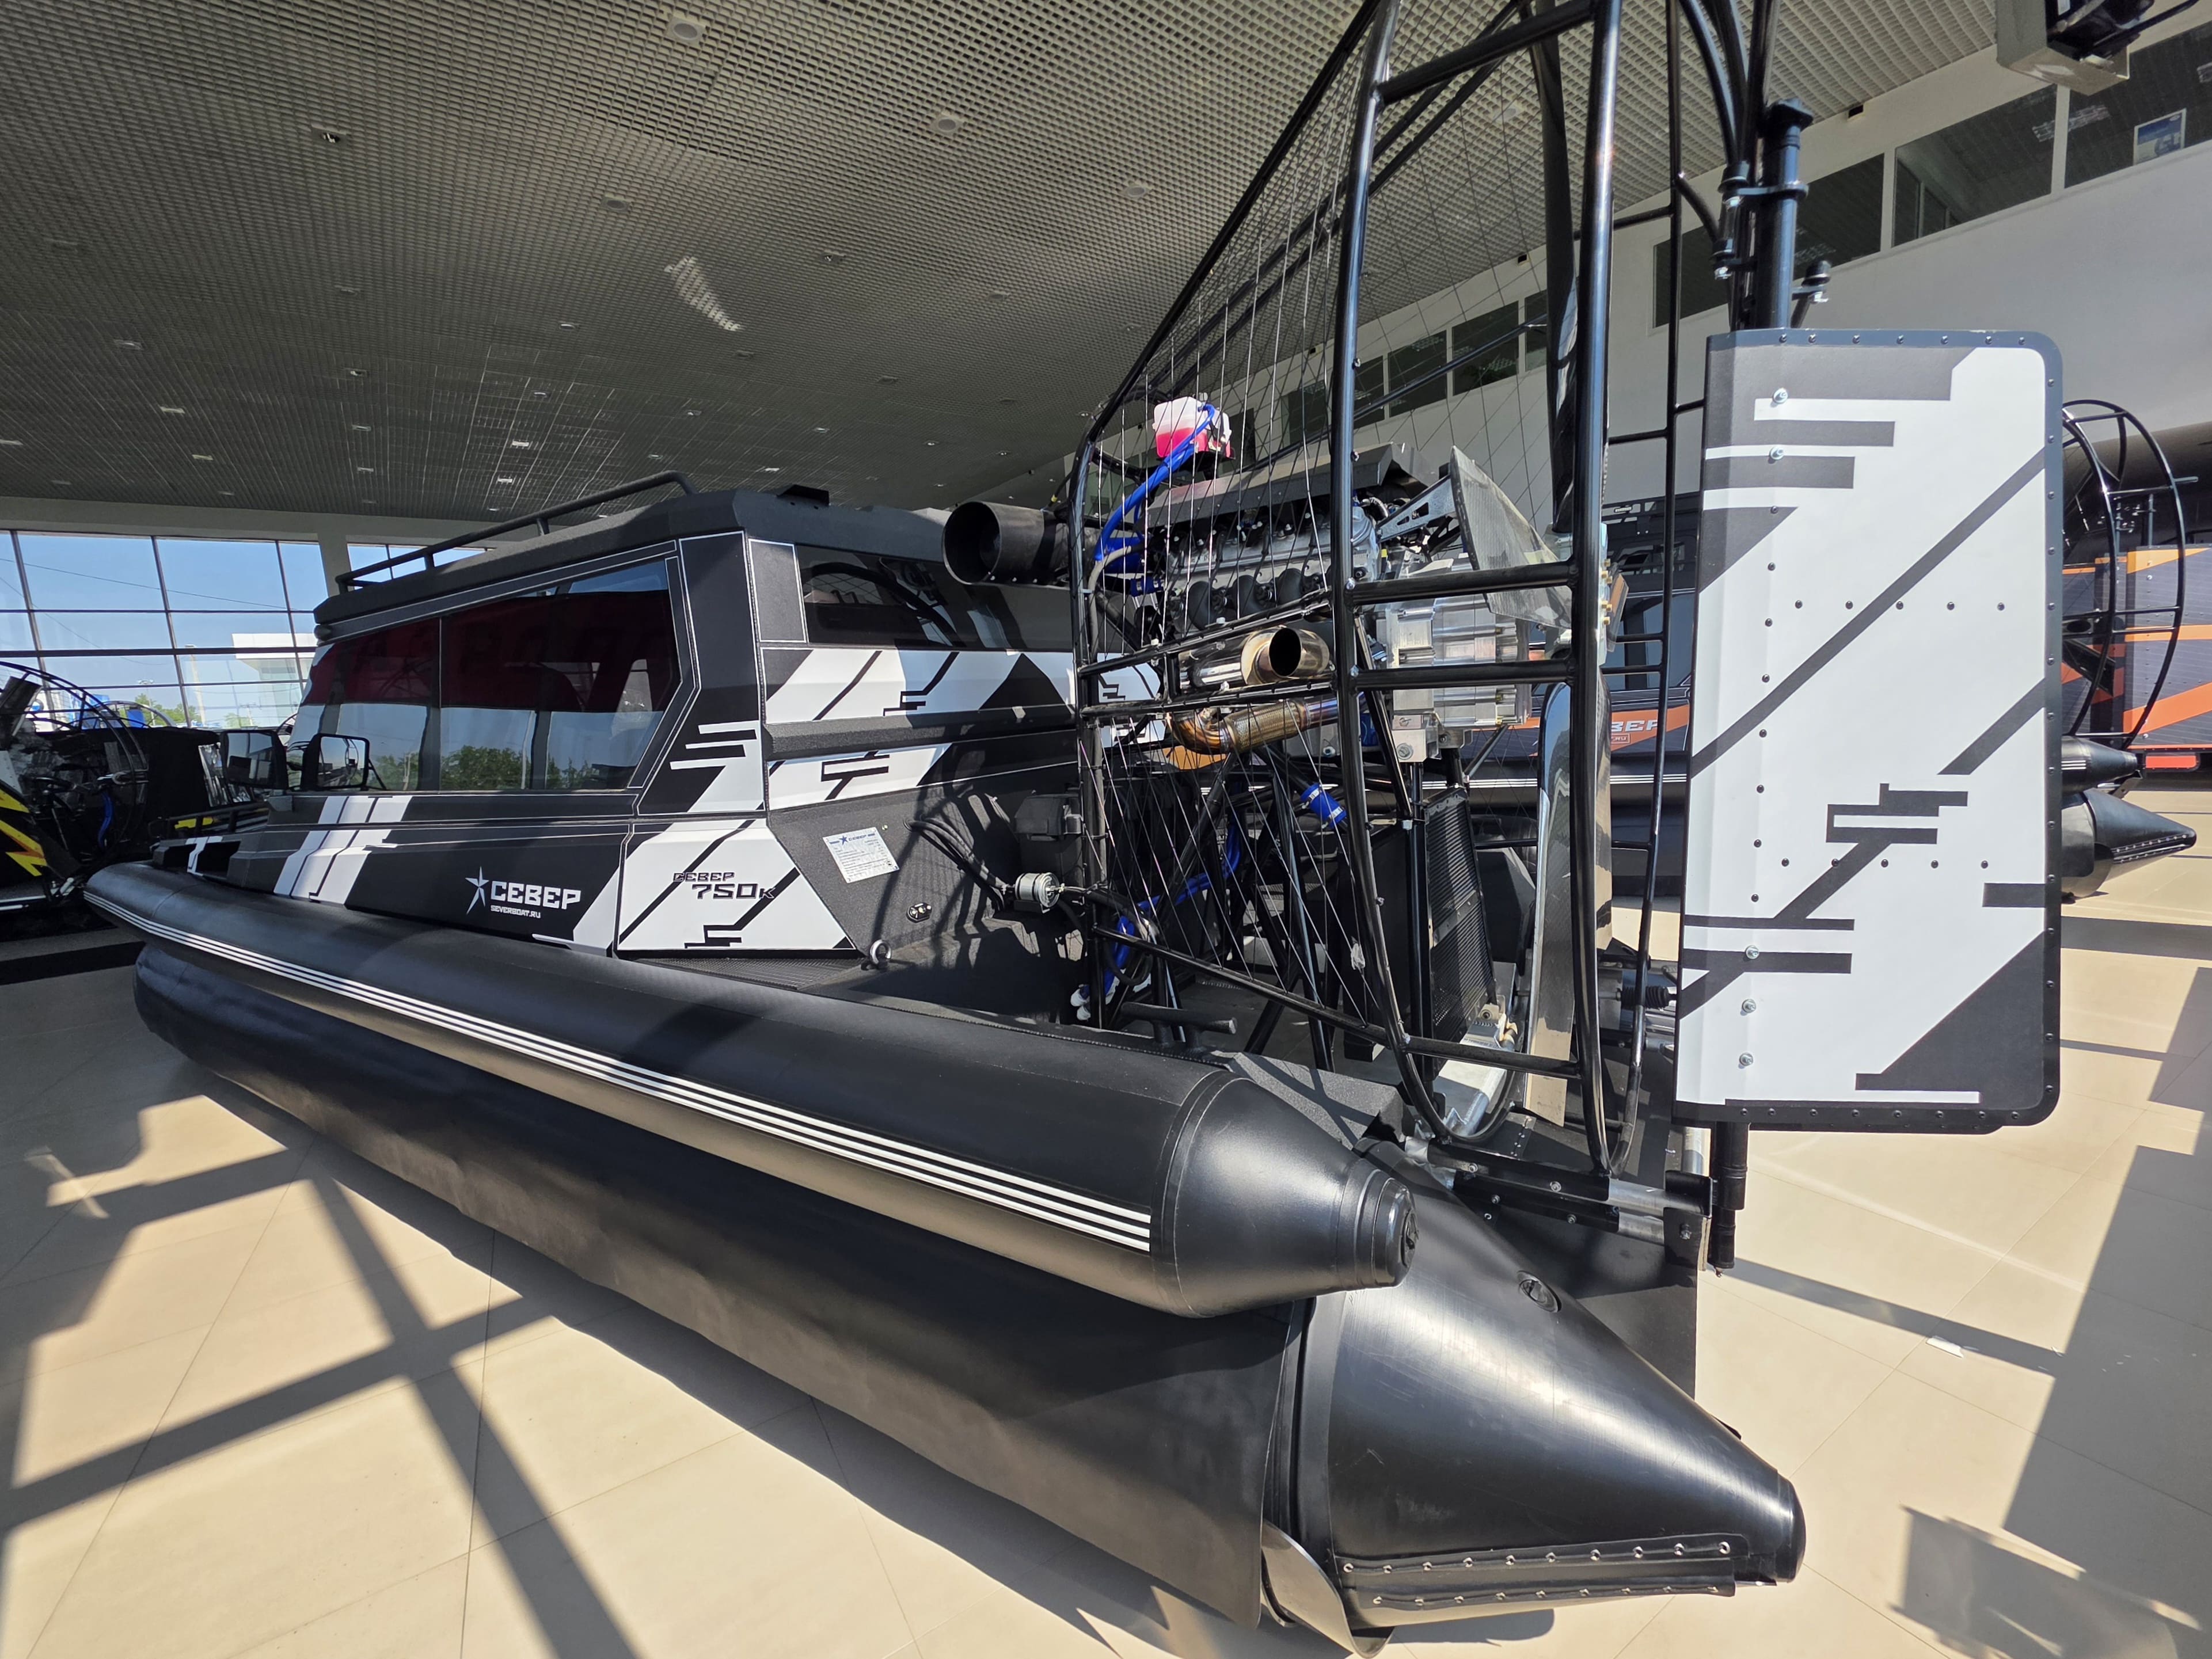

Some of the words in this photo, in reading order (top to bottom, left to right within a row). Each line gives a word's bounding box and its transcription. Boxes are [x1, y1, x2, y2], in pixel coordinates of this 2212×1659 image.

[1611, 719, 1658, 732] ВЕР
[673, 872, 735, 882] СЕВЕР
[491, 880, 581, 910] СЕВЕР
[491, 905, 541, 919] SEVERBOAT.RU
